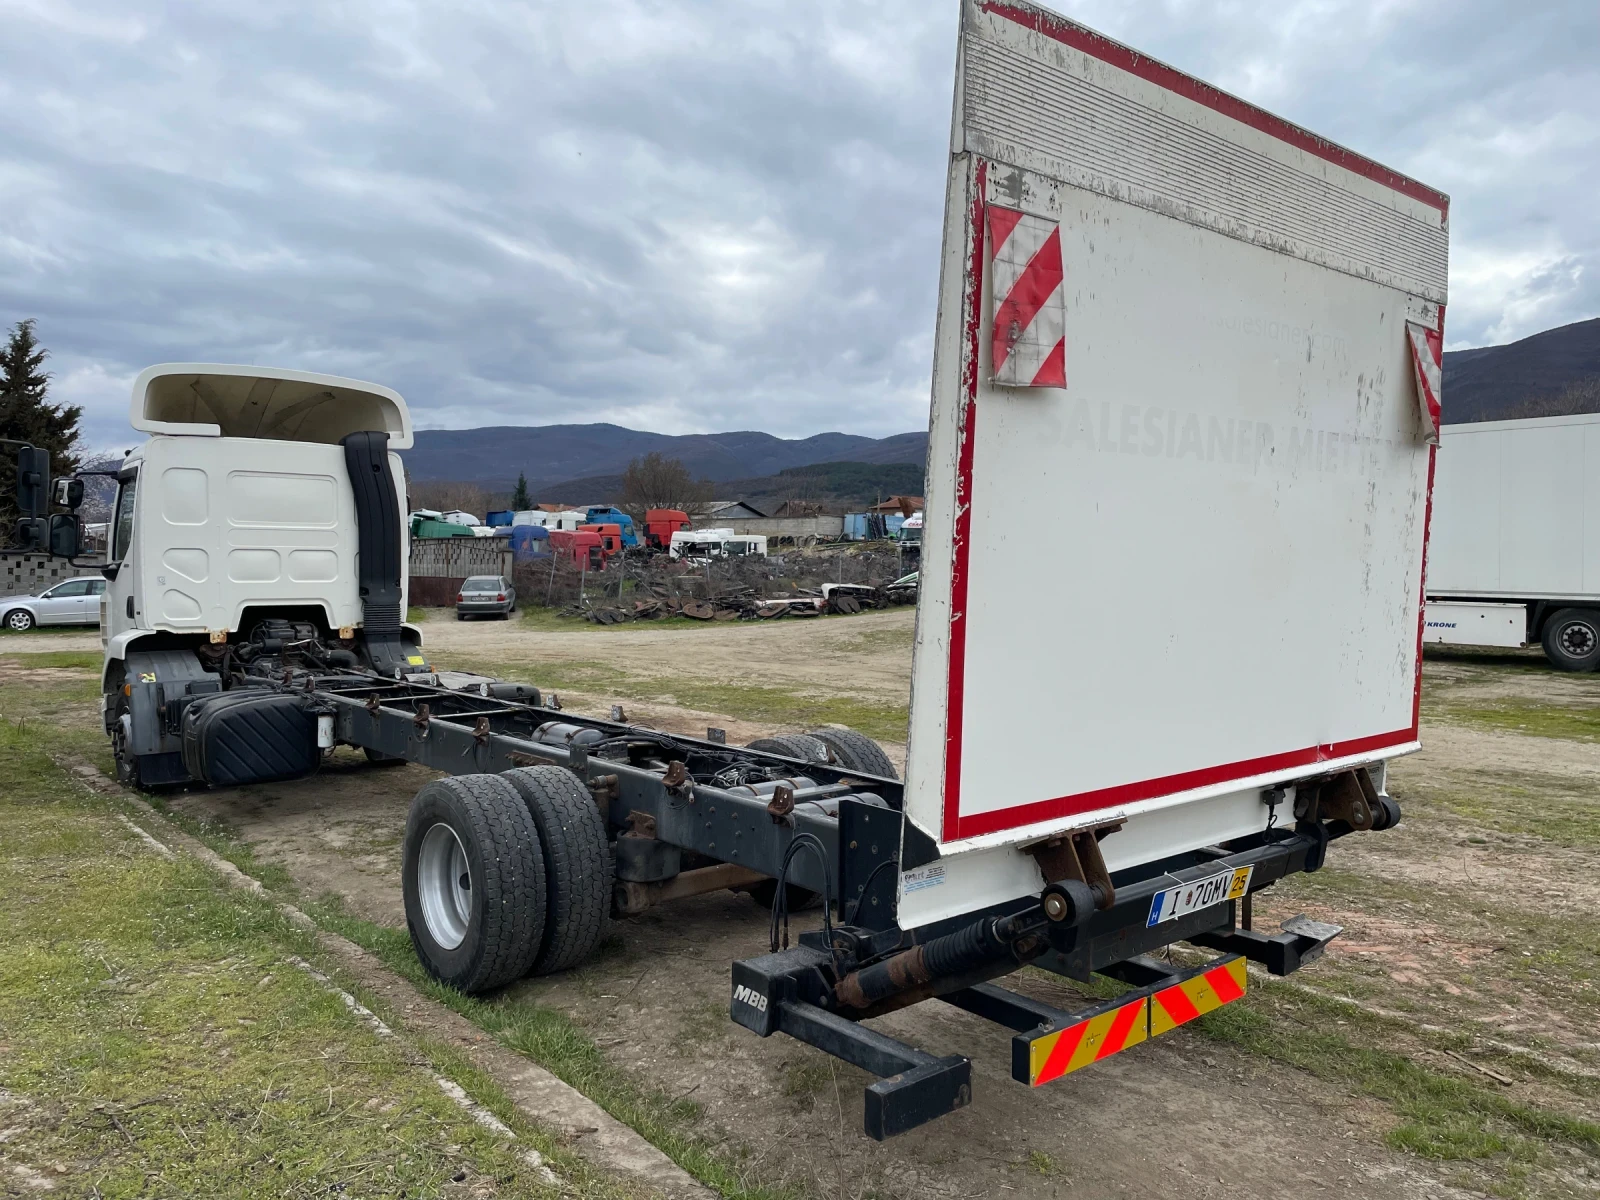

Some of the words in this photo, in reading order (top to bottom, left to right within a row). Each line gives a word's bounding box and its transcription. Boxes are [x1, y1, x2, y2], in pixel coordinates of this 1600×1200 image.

[1036, 397, 1275, 469] SALESIANER
[1427, 621, 1457, 629] KRONE
[1151, 911, 1158, 921] H
[1168, 890, 1181, 916] I
[1231, 875, 1247, 892] 25
[733, 984, 768, 1012] MBB
